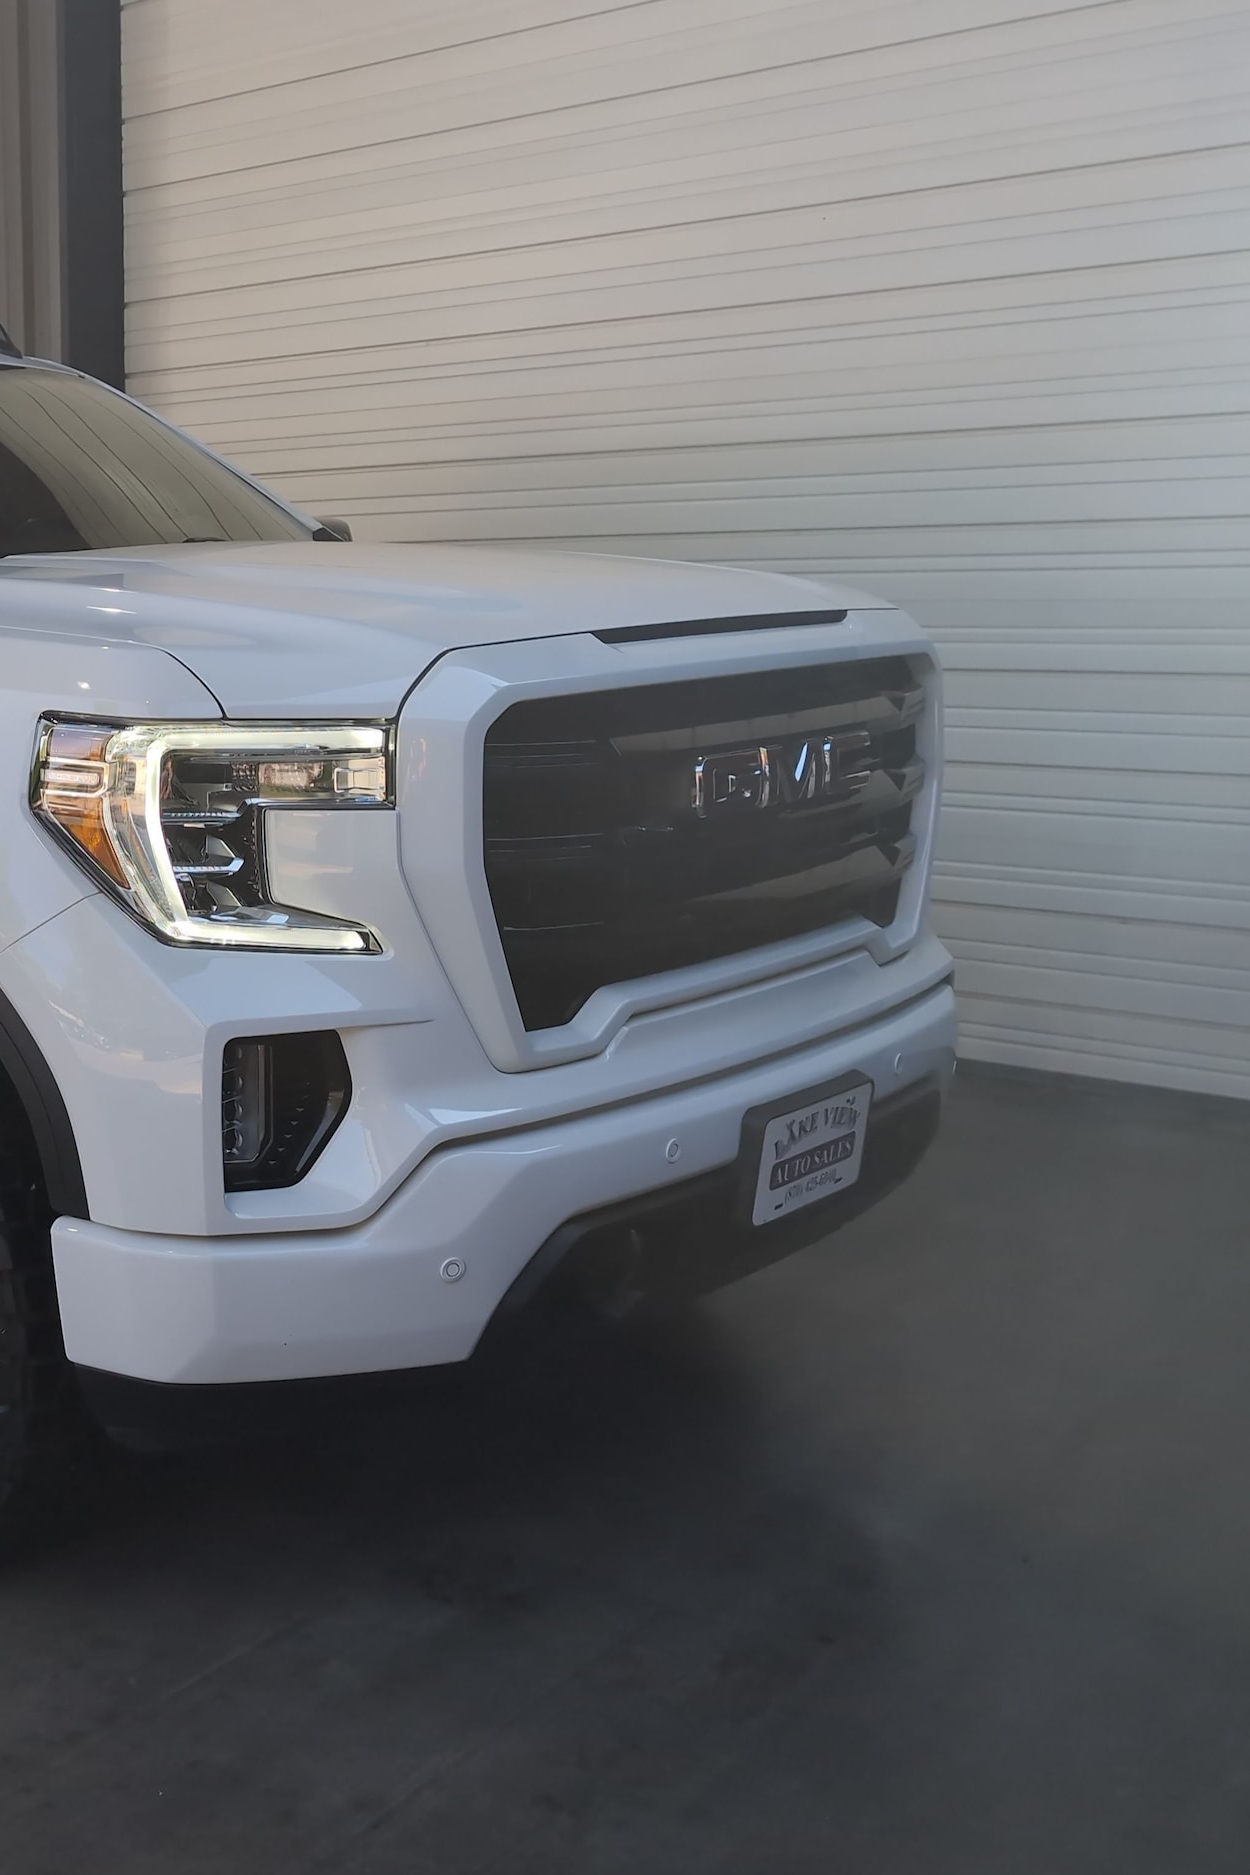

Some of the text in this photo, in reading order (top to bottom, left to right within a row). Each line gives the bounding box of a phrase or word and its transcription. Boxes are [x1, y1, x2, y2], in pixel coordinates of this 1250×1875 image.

[691, 731, 870, 816] GMC
[774, 1106, 861, 1160] LAKE VIEW
[776, 1141, 852, 1185] AUTO SALES
